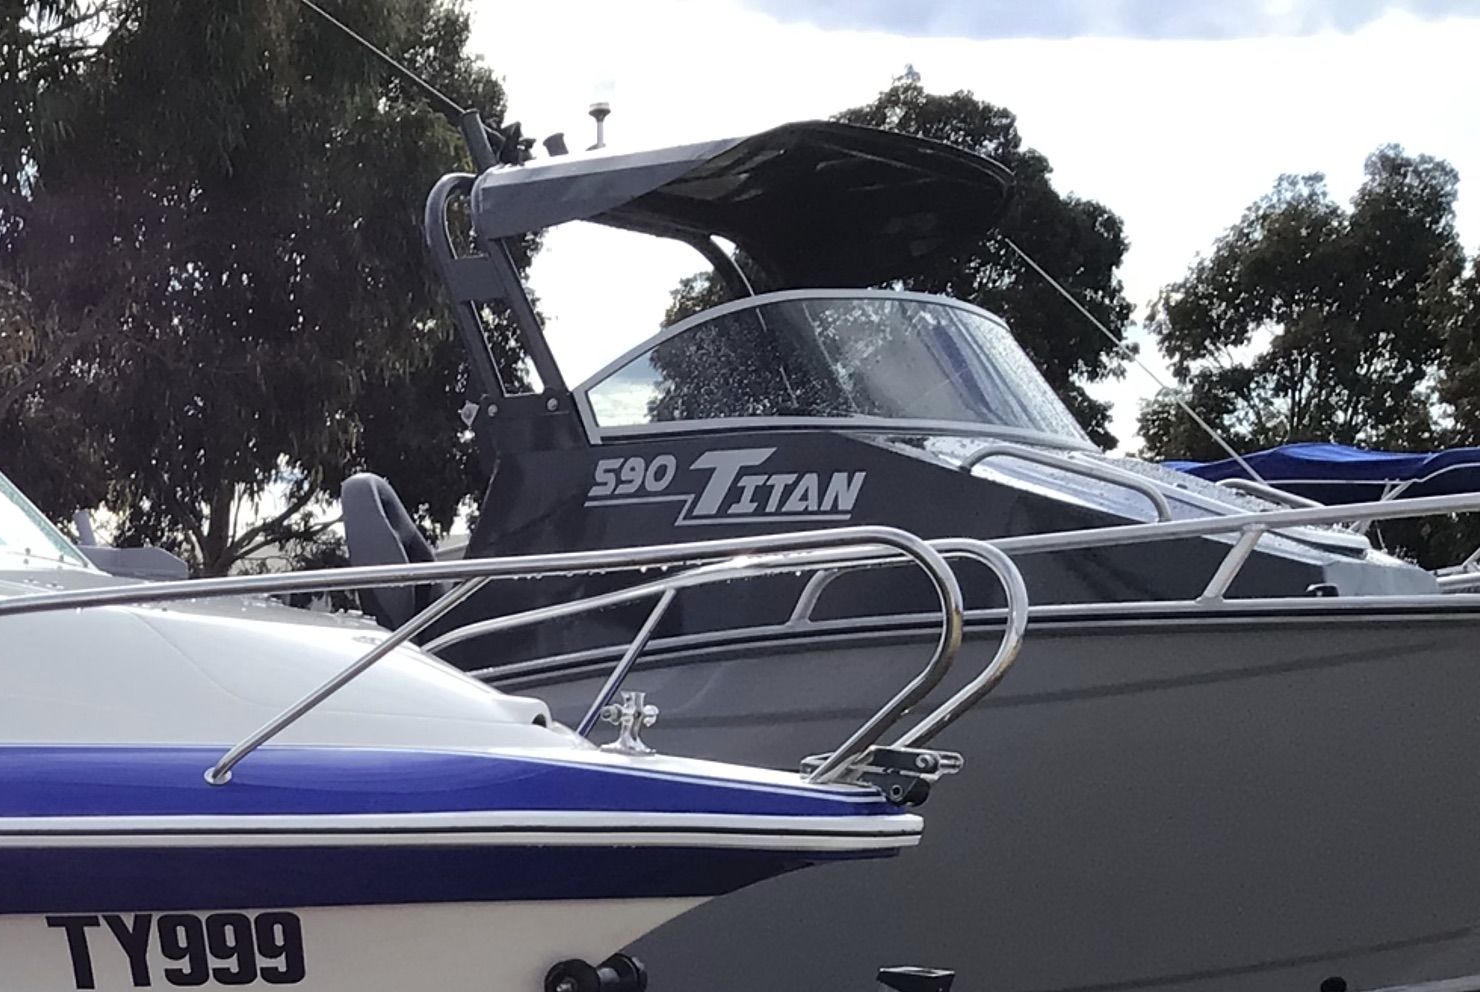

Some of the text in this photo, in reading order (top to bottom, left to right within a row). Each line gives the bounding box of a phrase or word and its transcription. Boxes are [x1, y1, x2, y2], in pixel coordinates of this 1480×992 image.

[587, 446, 867, 516] 590 TITAN
[45, 911, 306, 990] TY999
